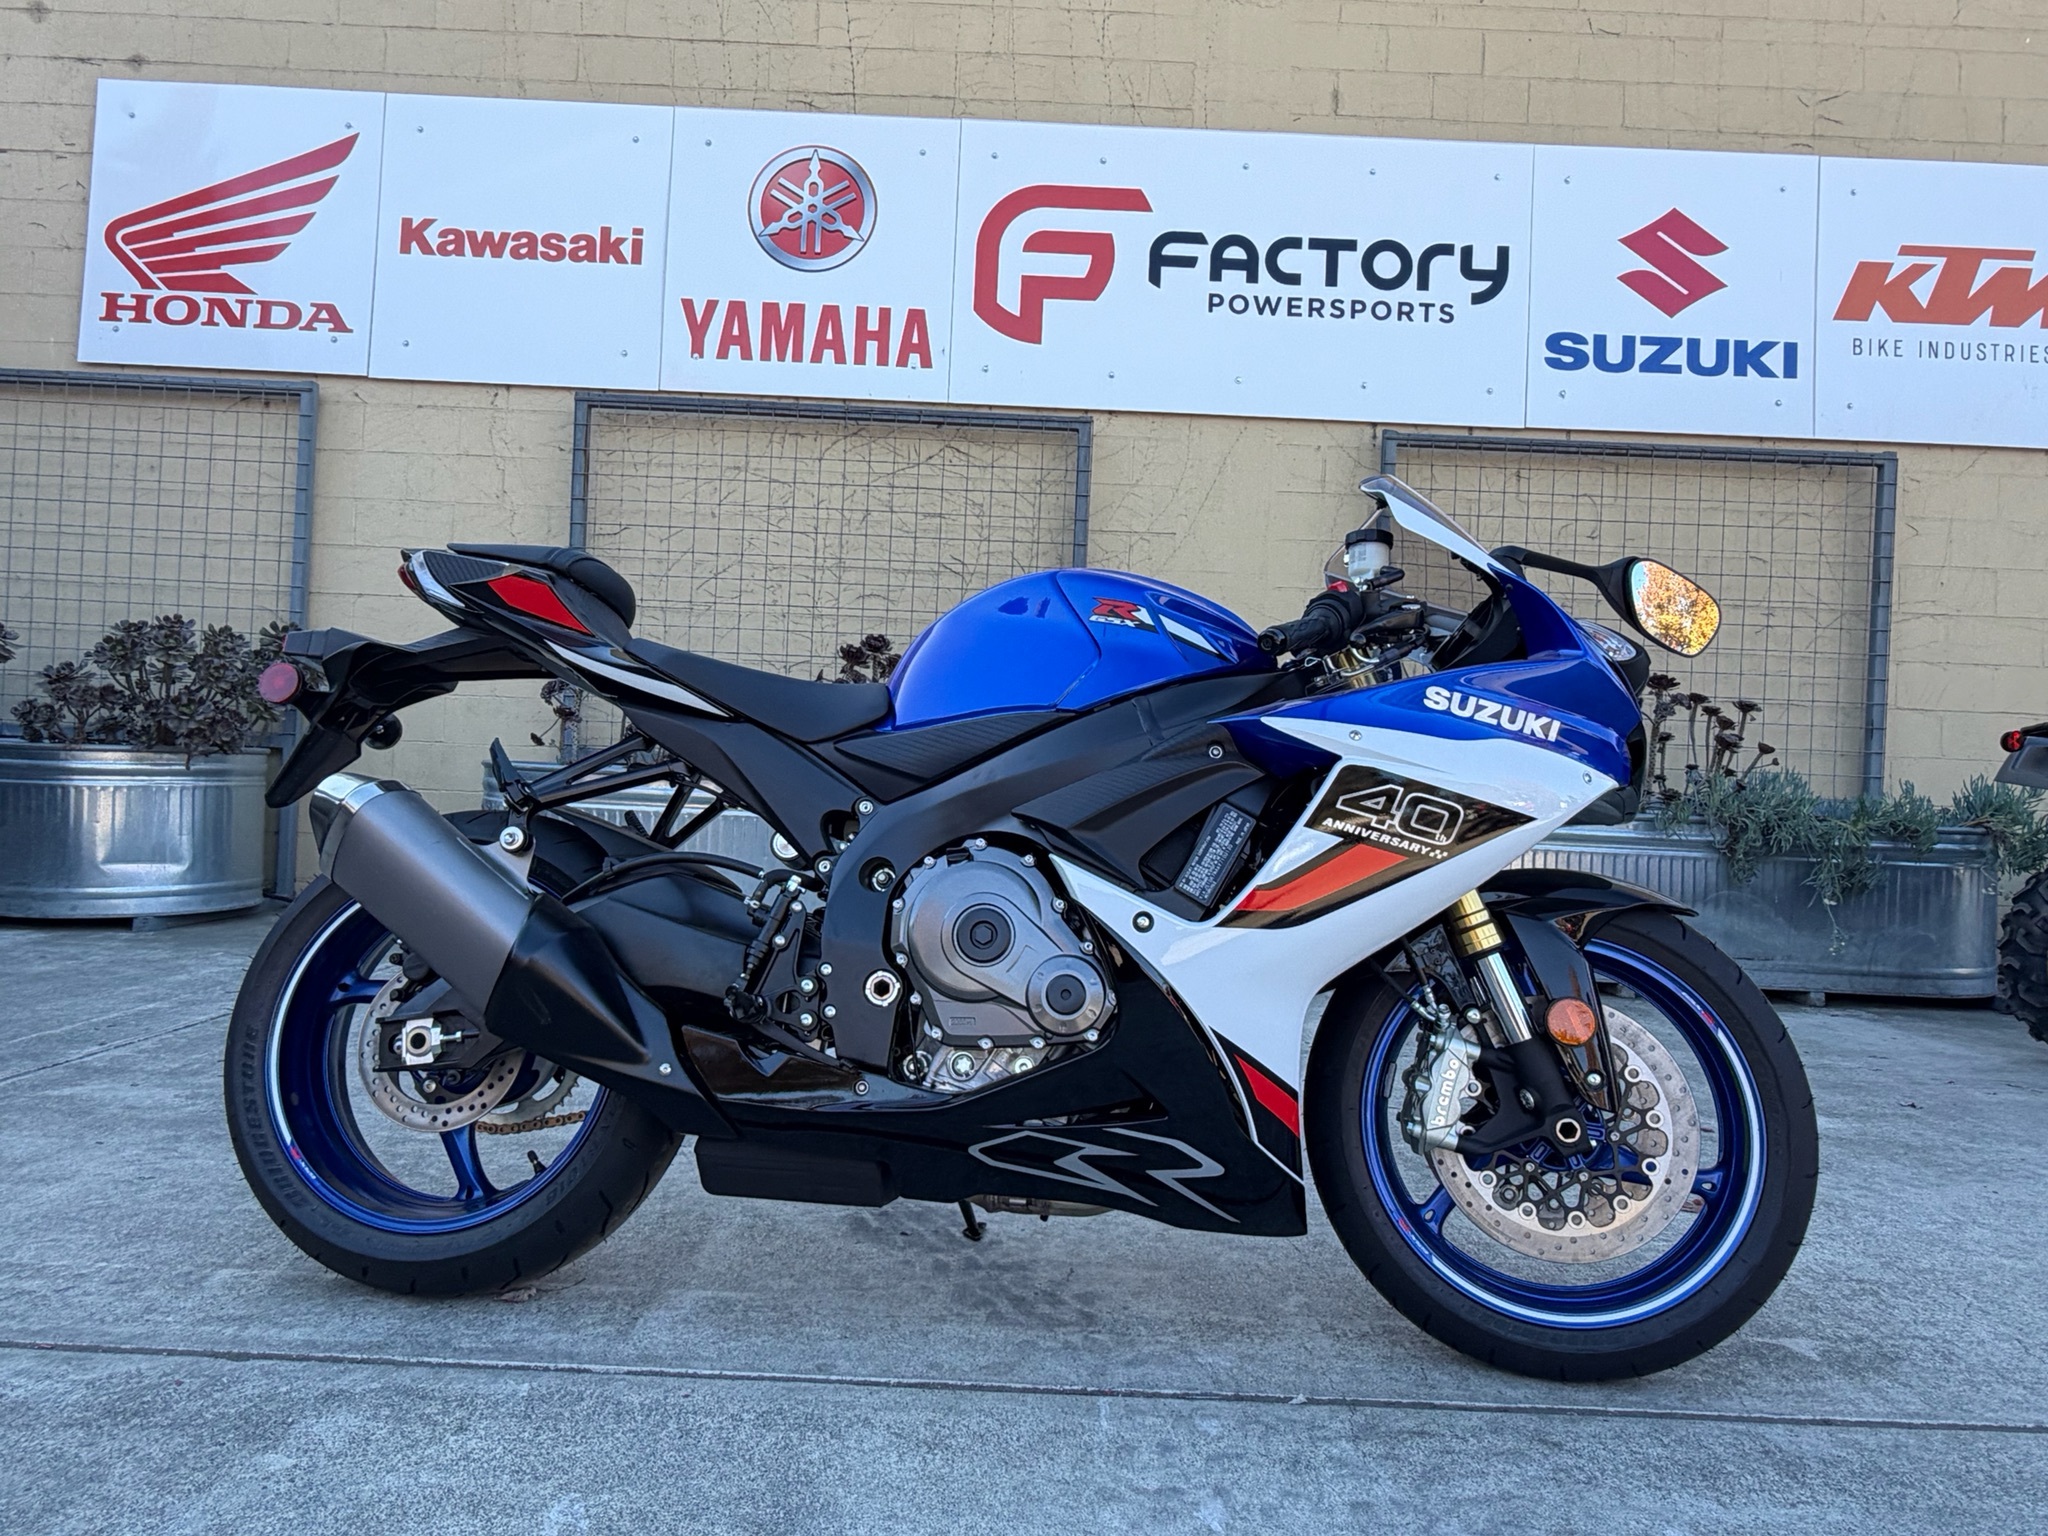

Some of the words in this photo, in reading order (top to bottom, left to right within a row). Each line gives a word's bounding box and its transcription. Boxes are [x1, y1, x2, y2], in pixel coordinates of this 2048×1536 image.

[400, 217, 644, 265] Kawasaki
[1208, 291, 1456, 325] POWERSPORTS
[1833, 245, 2048, 329] KTM
[99, 291, 353, 333] HONDA
[681, 298, 932, 369] YAMAHA
[1545, 331, 1799, 379] SUZUKI
[1852, 337, 1904, 358] BIKE
[1423, 686, 1562, 743] SUZUKI
[1321, 816, 1432, 856] ANNIVERSARY
[1430, 1058, 1460, 1127] brembo
